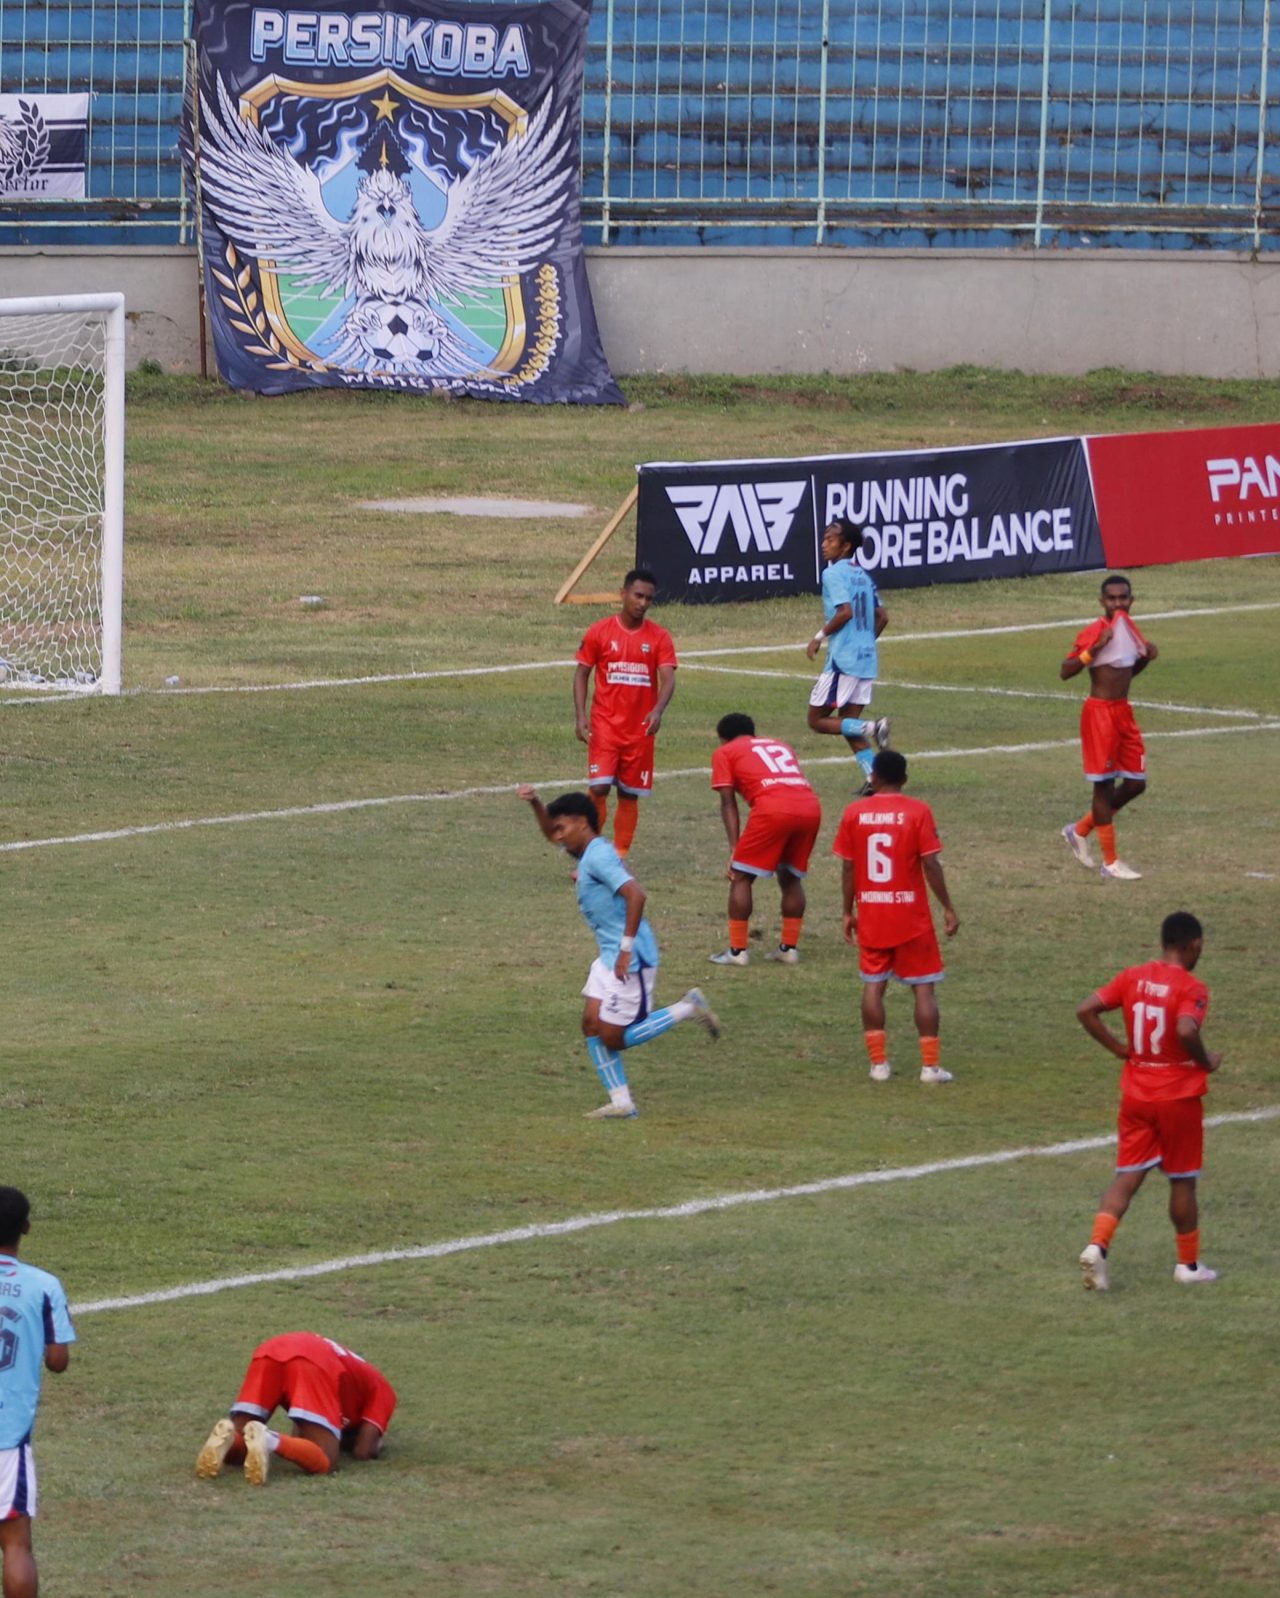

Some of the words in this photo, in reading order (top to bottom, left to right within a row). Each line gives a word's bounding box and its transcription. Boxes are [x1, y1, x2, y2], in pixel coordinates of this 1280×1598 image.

[250, 6, 531, 79] PERSIKOBA
[825, 473, 969, 526] RUNNING
[850, 522, 924, 571] ORE
[927, 507, 1074, 565] BALANCE
[688, 563, 795, 585] APPAREL
[751, 744, 801, 774] 12
[867, 831, 893, 883] 6
[1131, 1001, 1166, 1056] 17
